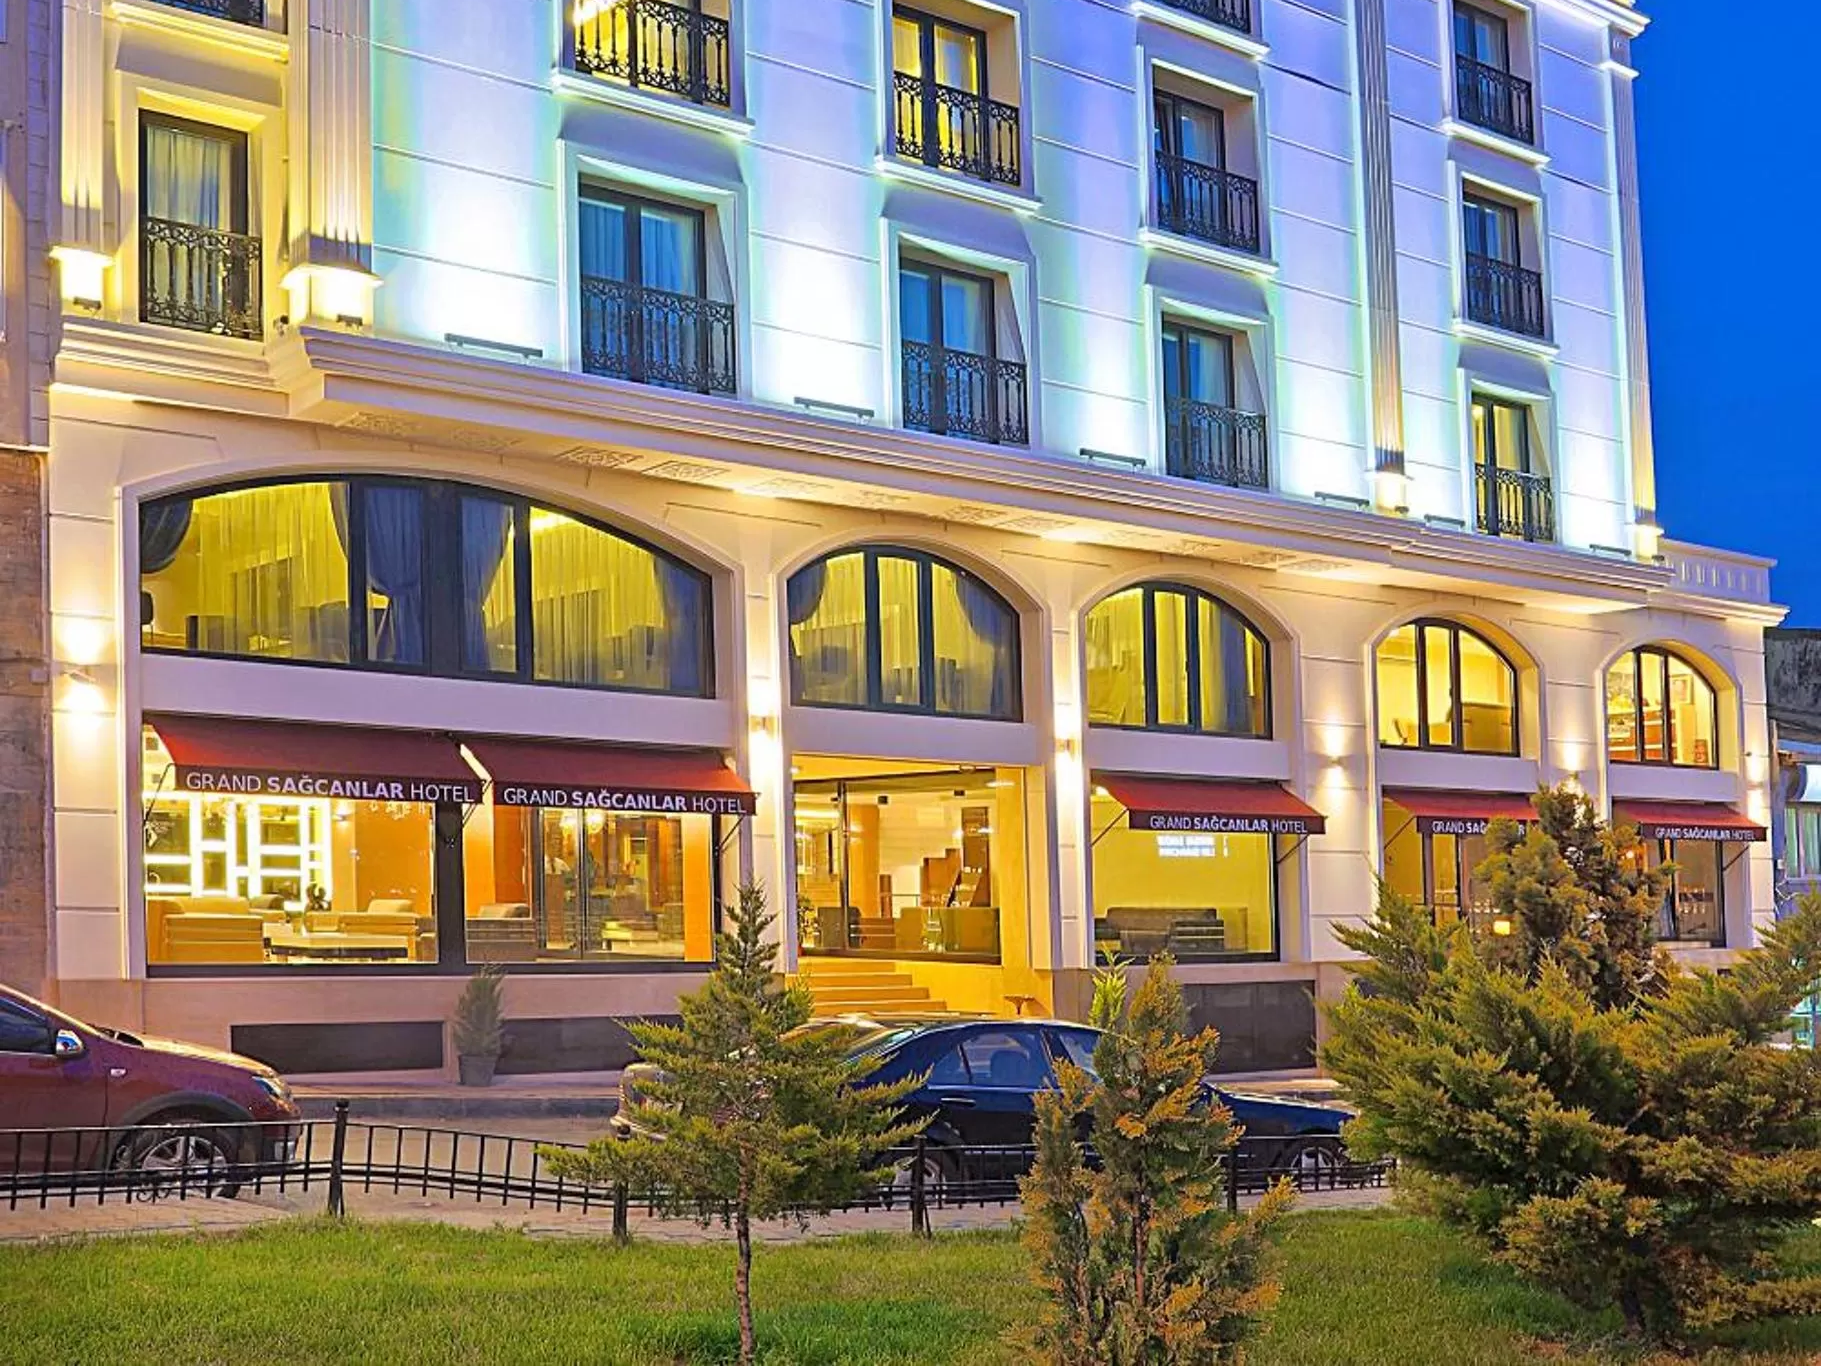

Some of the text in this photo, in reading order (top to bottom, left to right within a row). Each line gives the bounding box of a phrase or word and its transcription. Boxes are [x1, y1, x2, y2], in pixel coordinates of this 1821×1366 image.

[186, 771, 475, 803] GRAND SAĞCANLAR HOTEL
[503, 787, 747, 814] GRAND SAĞCANLAR HOTEL
[1150, 815, 1308, 834] GRAND SAĞCANLAR HOTEL
